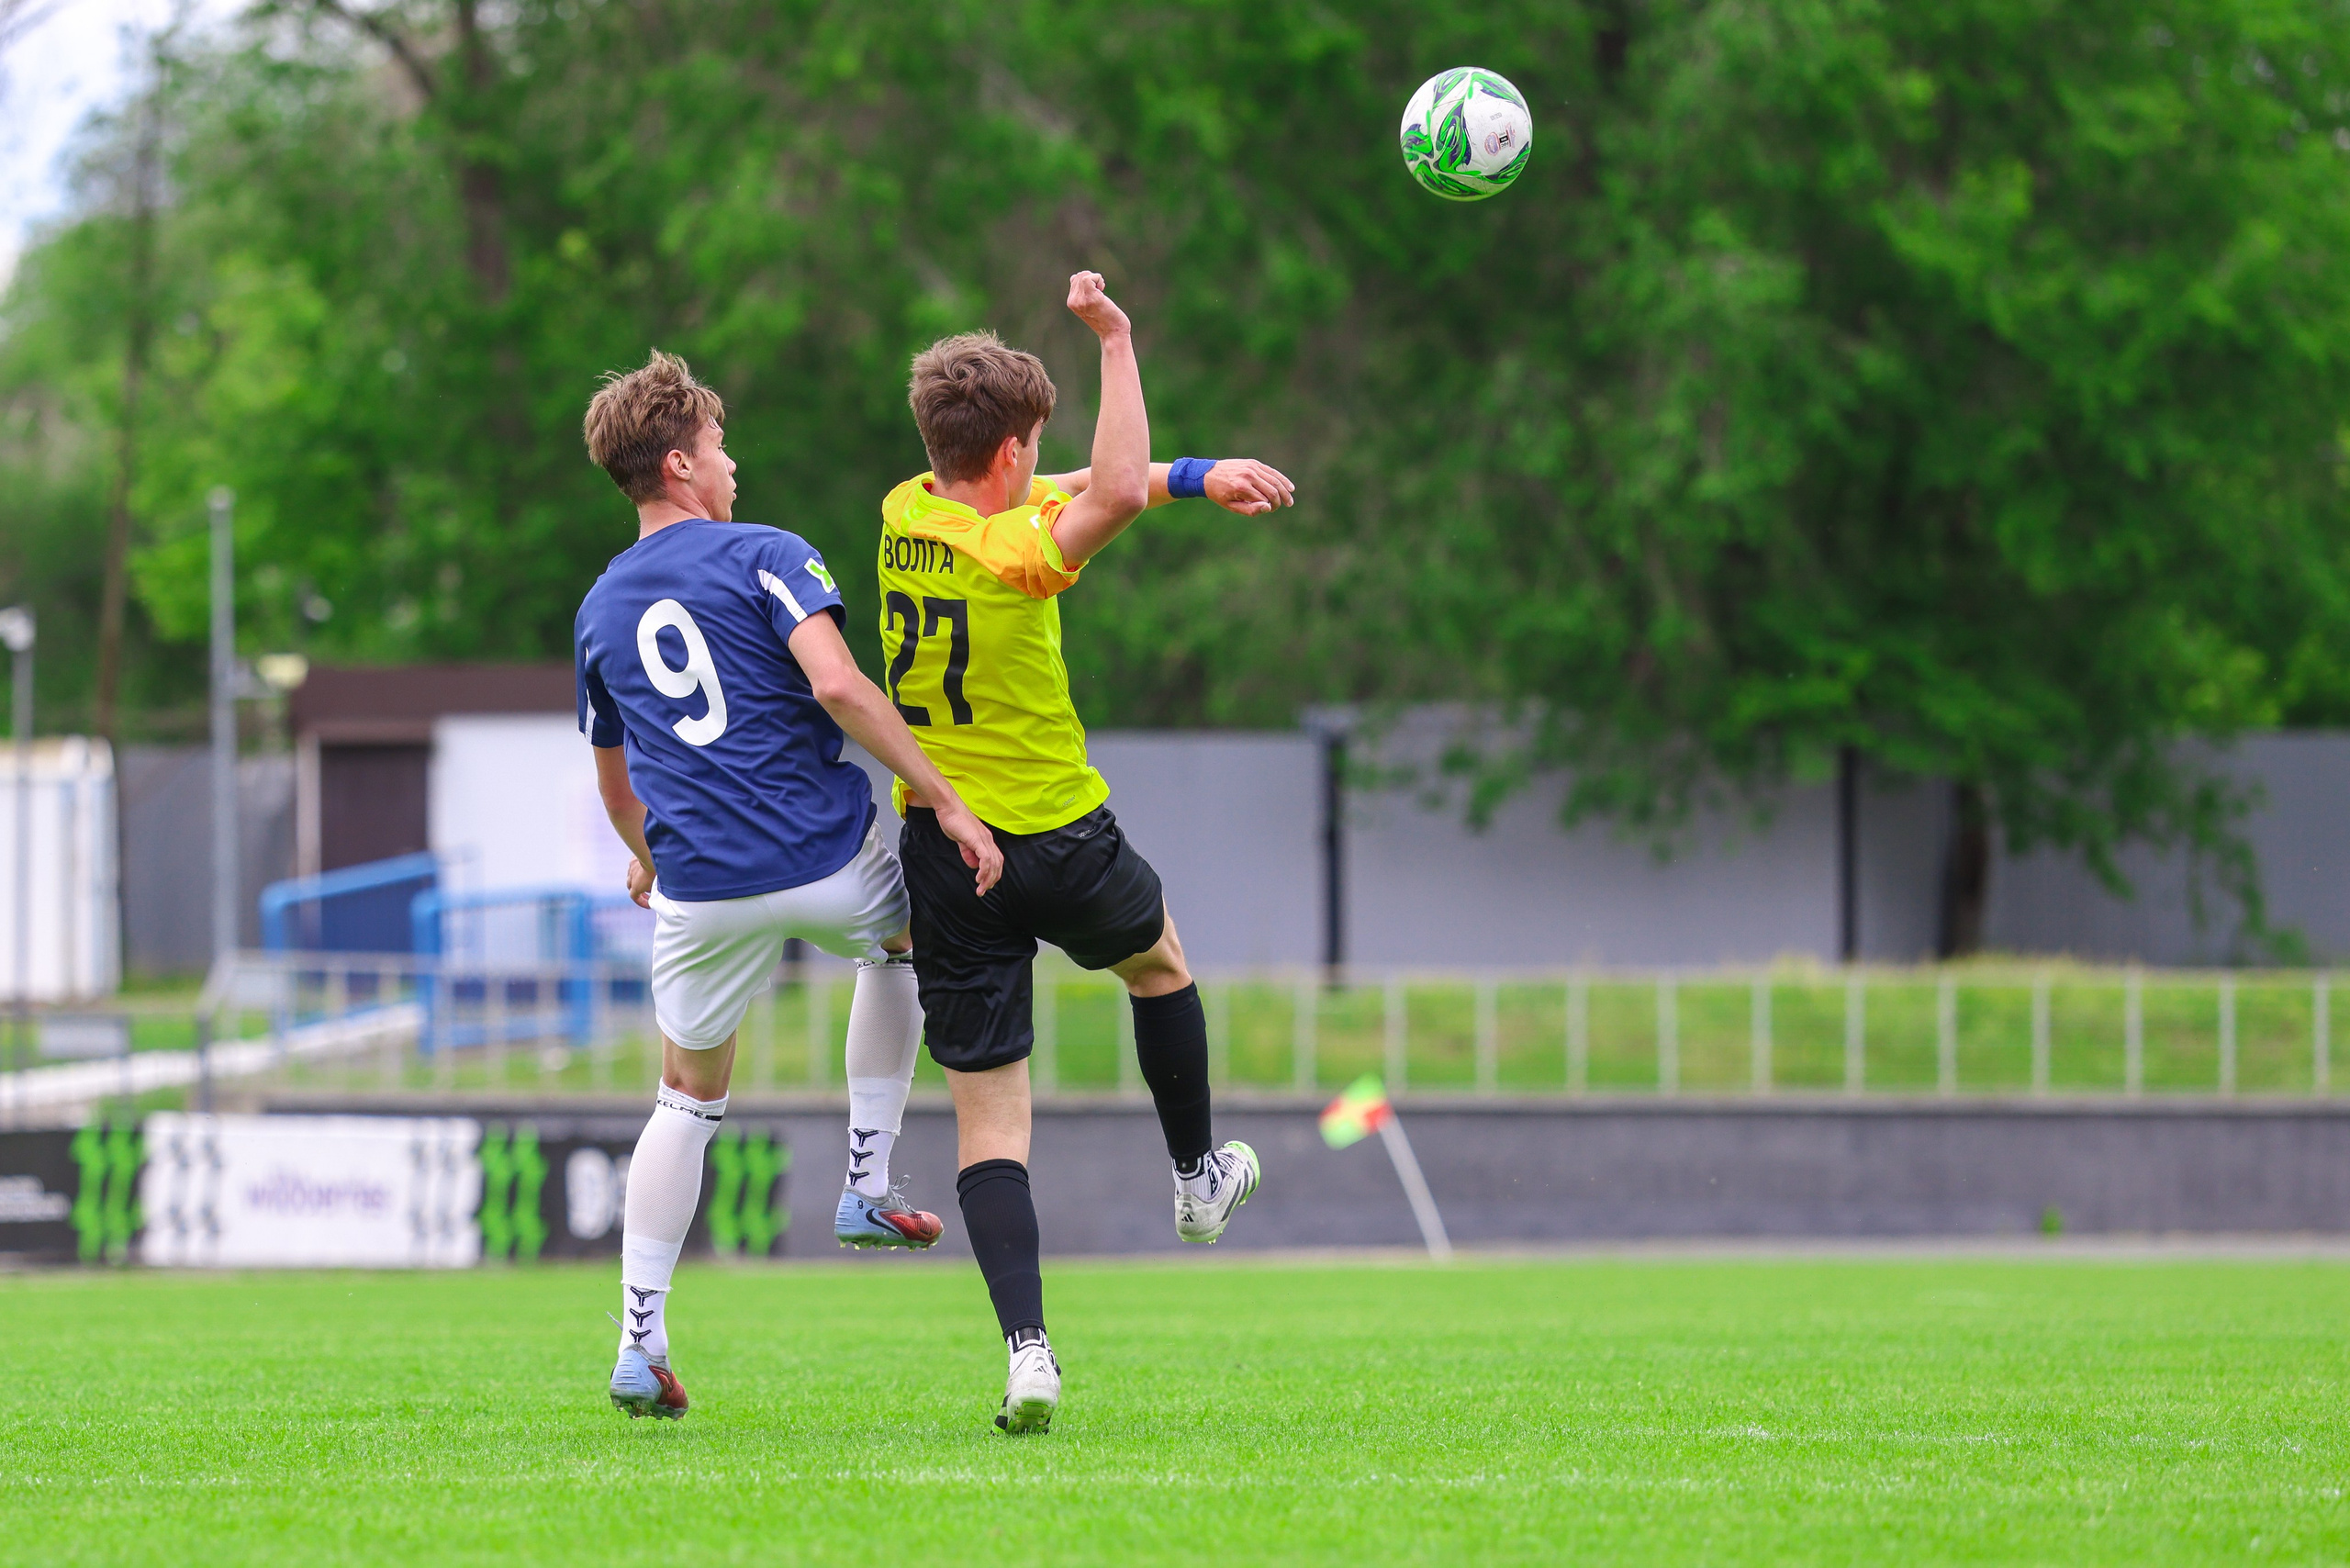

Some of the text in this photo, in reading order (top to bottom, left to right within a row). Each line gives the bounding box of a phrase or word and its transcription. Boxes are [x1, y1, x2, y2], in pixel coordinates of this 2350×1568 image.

[884, 533, 954, 575] ВОЛГА
[636, 598, 728, 747] 9
[884, 590, 974, 727] 27
[857, 1199, 865, 1210] 9
